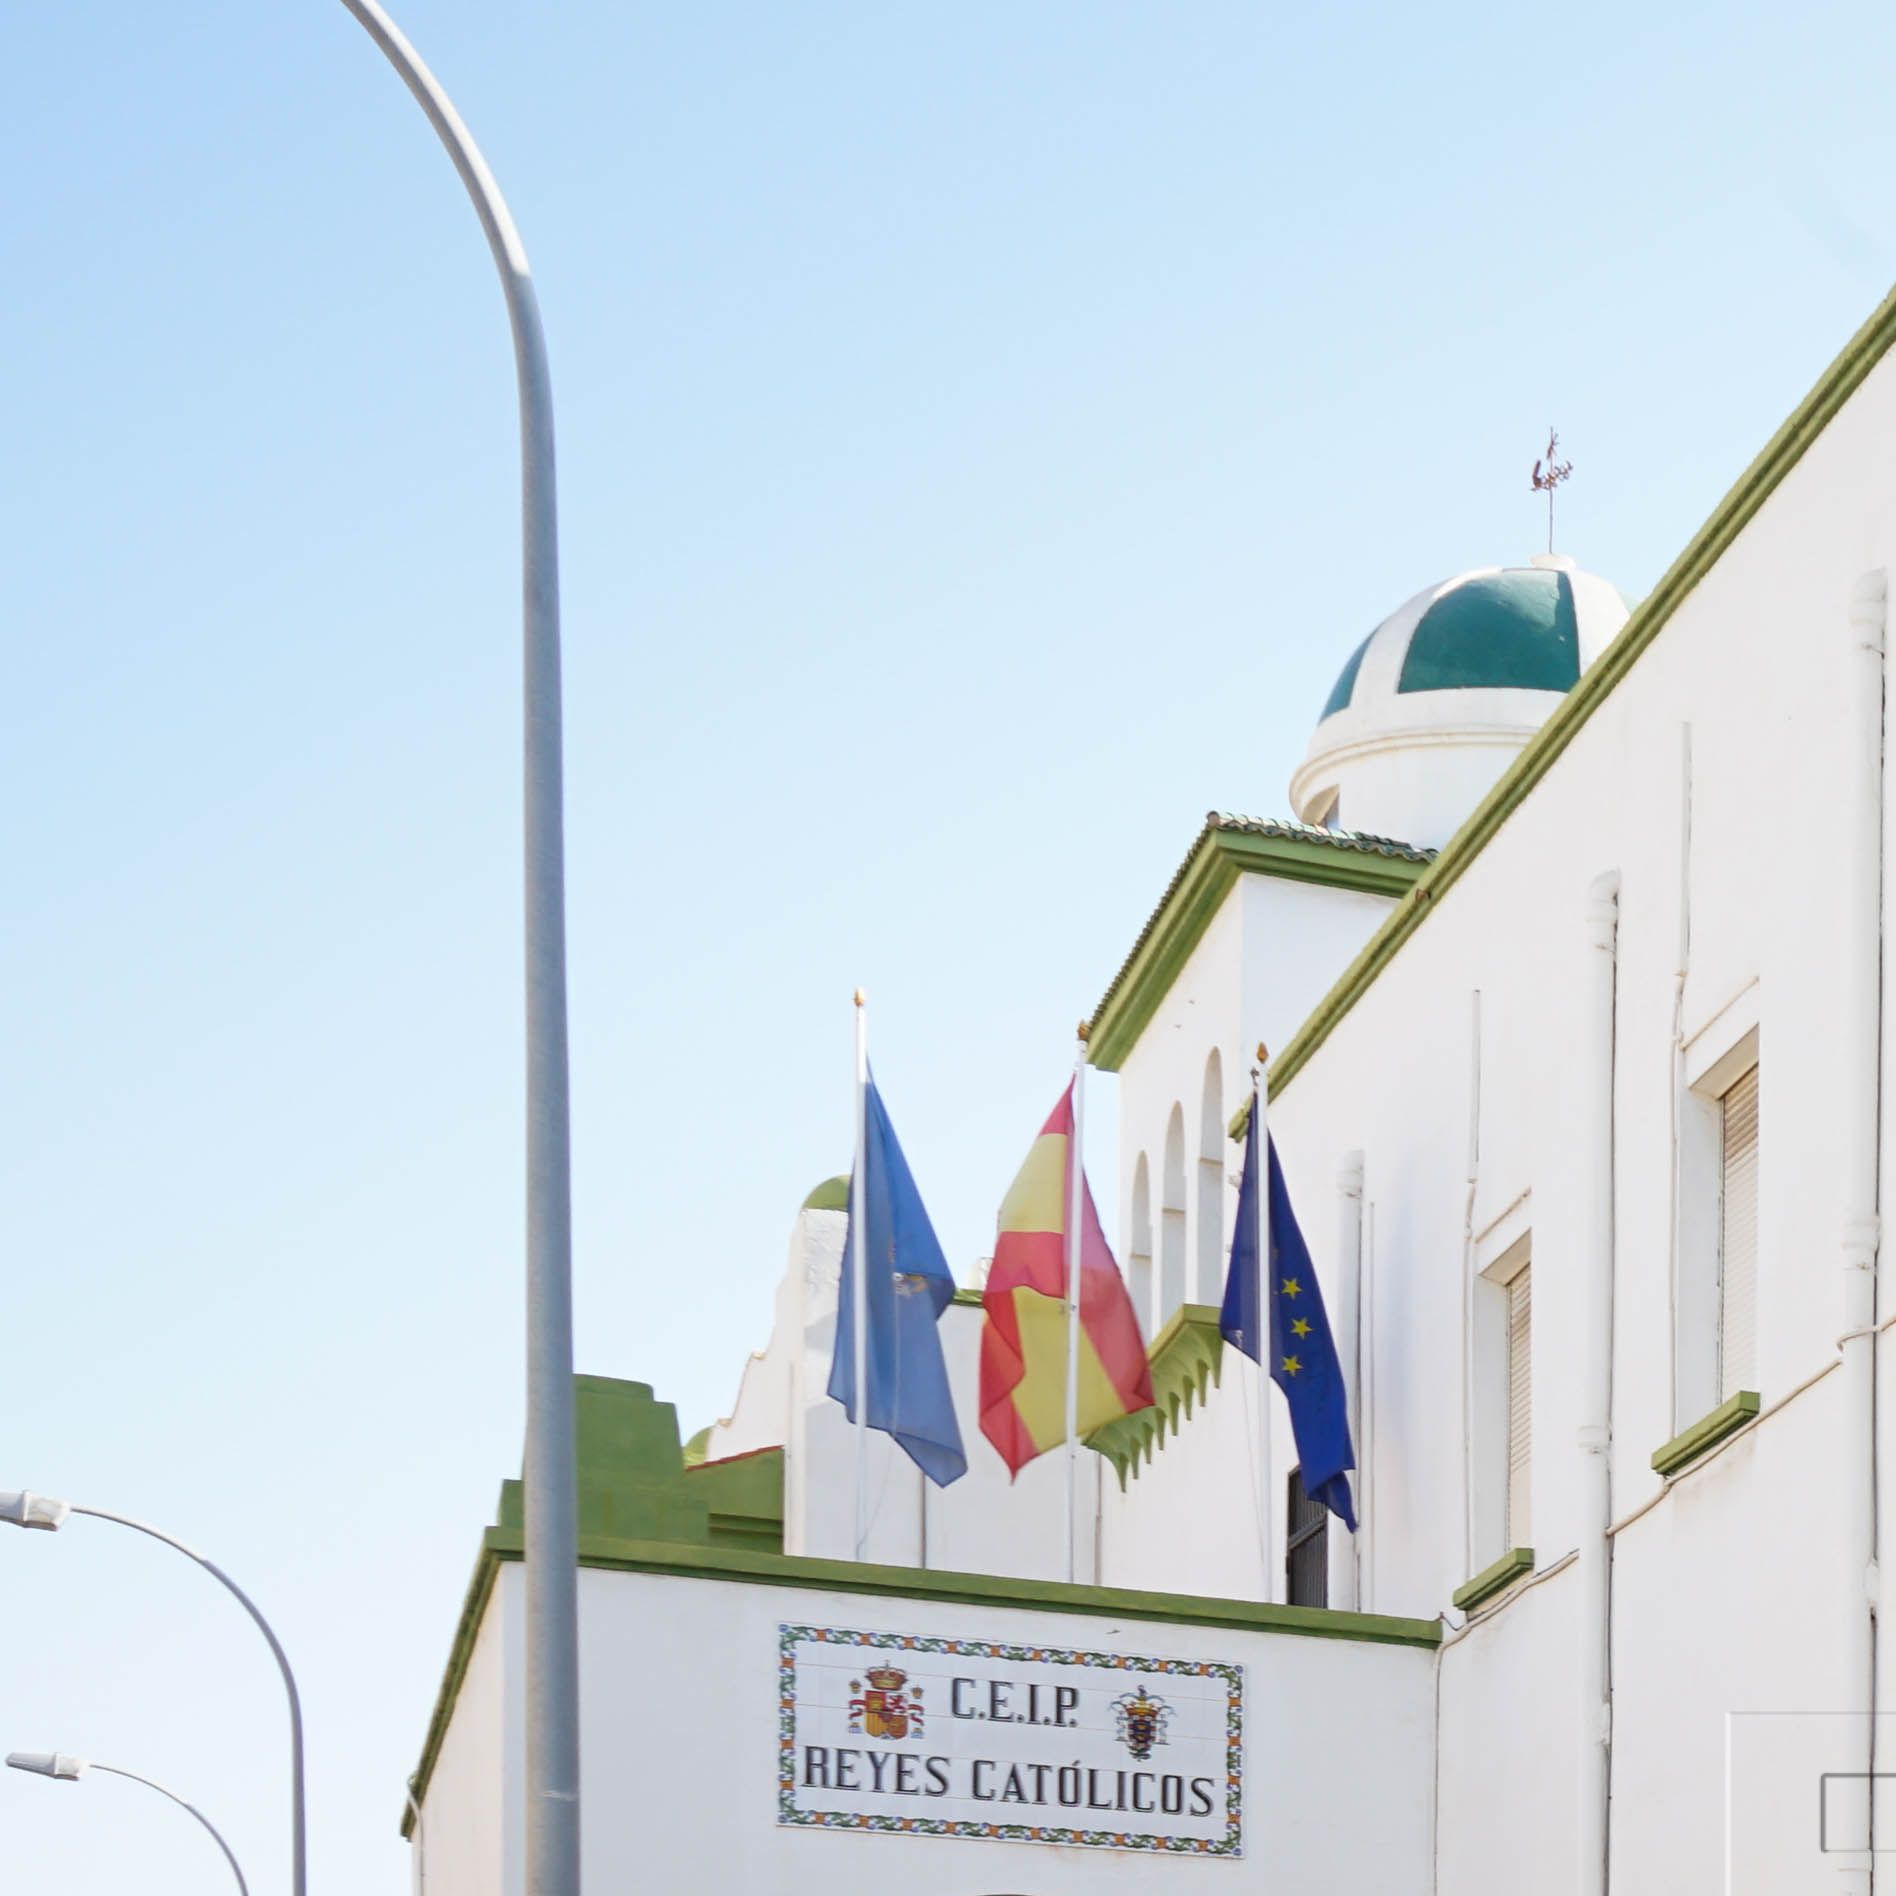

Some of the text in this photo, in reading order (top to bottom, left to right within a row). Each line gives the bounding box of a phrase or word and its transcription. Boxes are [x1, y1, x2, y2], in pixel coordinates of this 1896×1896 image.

[950, 1677, 1080, 1727] C.E.I.P.
[803, 1745, 1215, 1818] REYES CATÓLICOS
